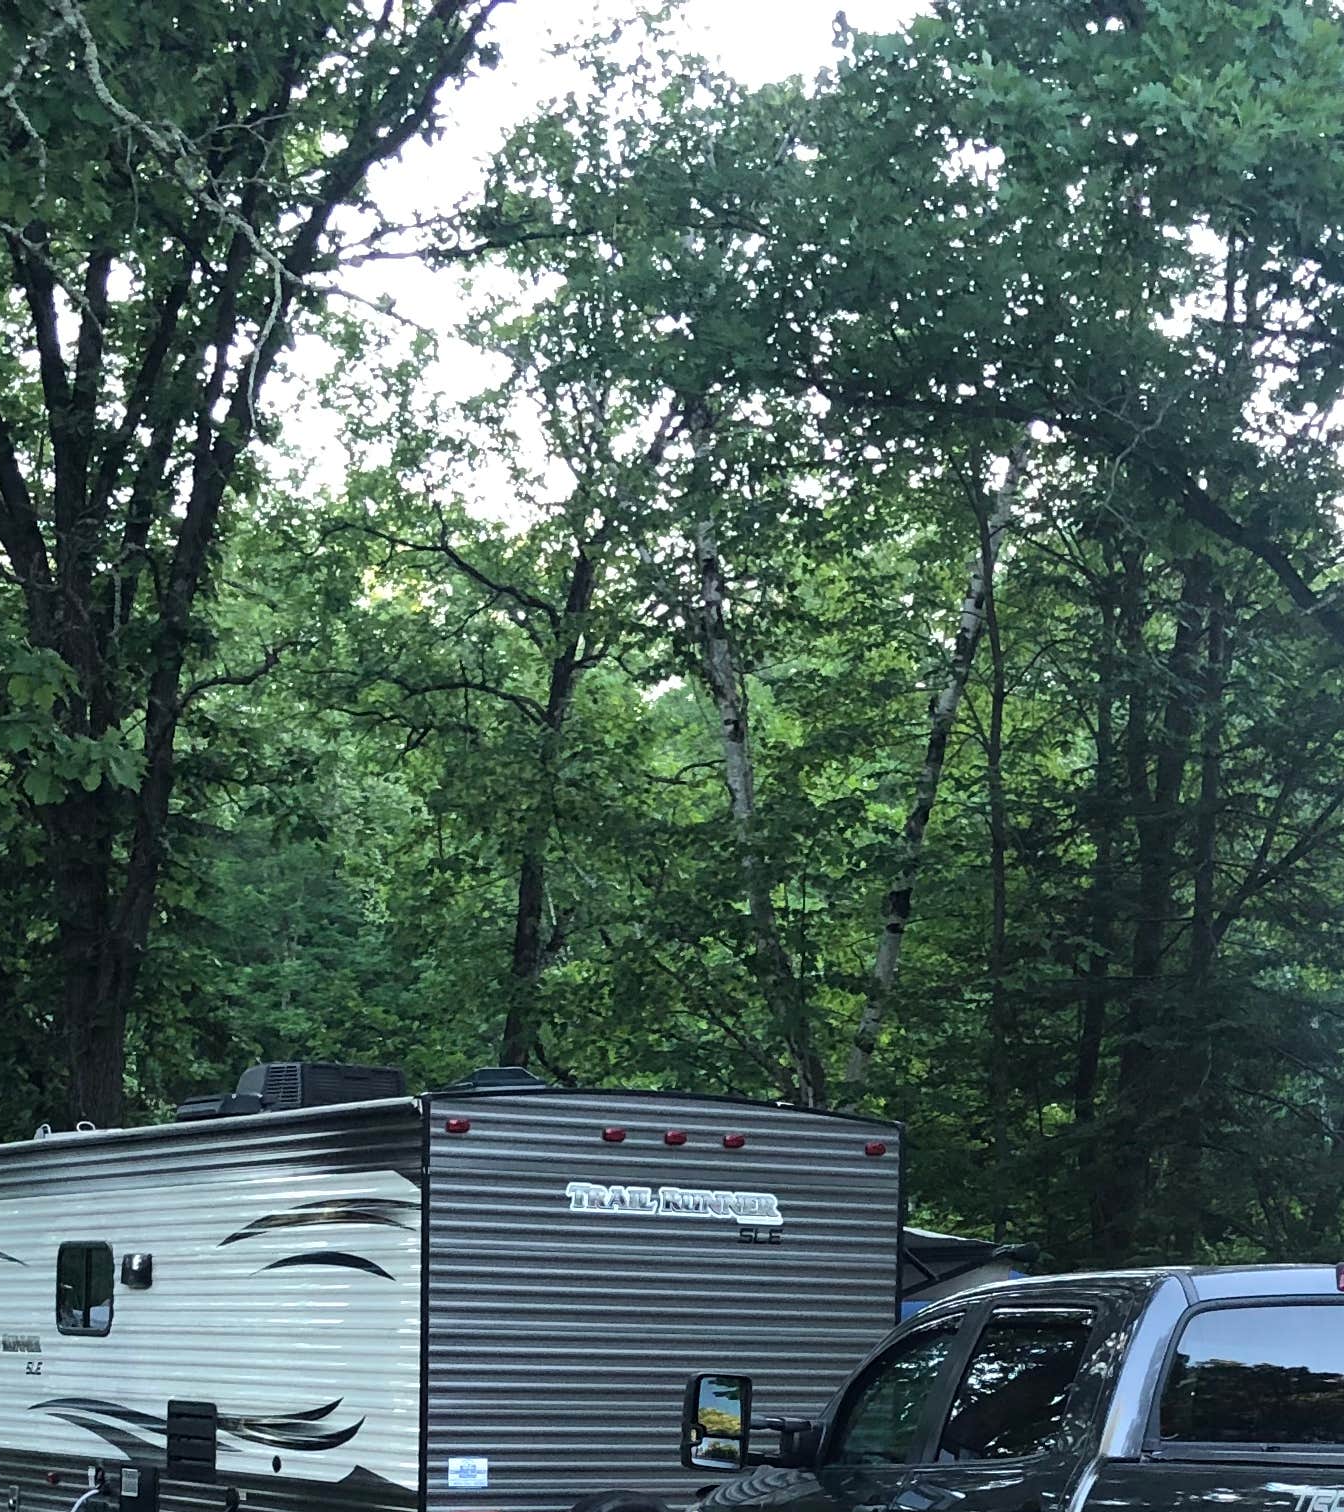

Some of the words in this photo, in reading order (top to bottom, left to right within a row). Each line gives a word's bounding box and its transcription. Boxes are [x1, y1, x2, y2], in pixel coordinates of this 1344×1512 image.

[567, 1184, 656, 1213] TRAIL
[659, 1187, 782, 1219] RUNNER
[737, 1228, 784, 1245] SLE
